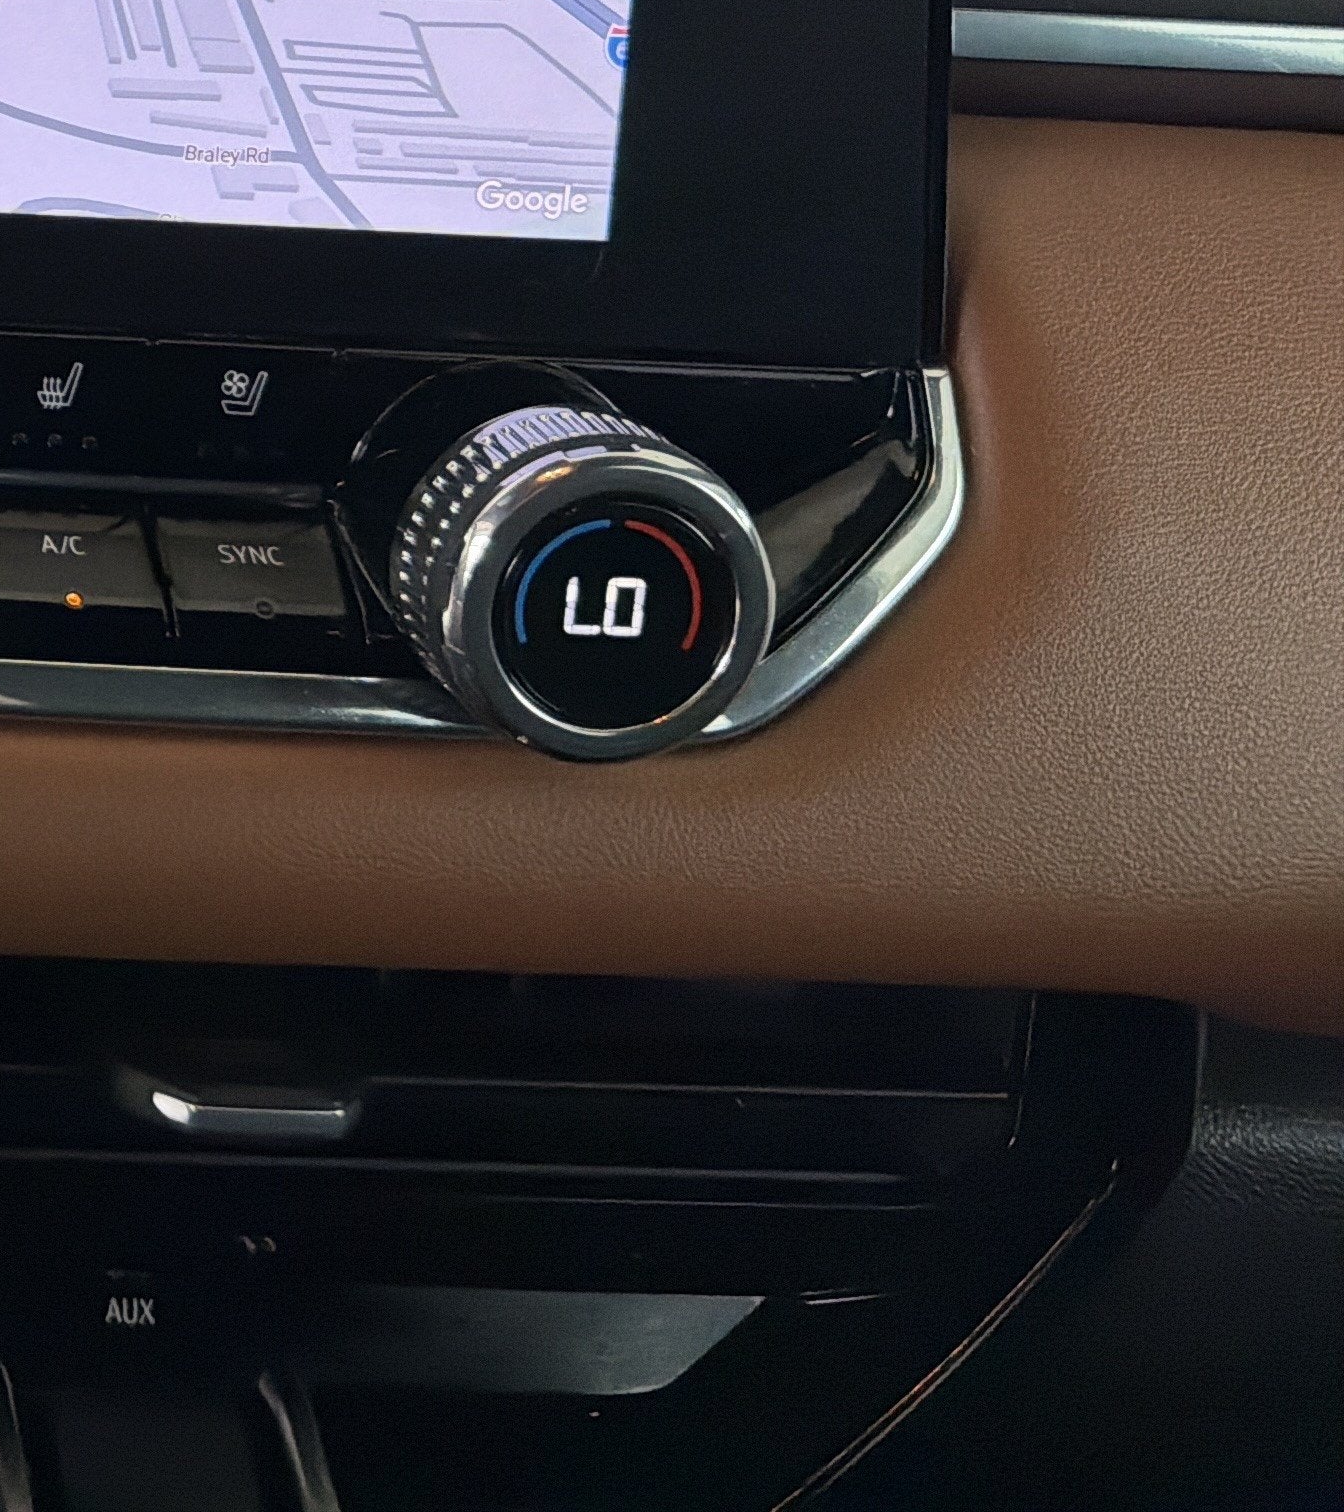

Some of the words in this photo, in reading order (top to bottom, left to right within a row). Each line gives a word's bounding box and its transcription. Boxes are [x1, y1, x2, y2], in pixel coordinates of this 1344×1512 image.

[184, 144, 240, 167] Braley
[245, 146, 270, 164] Rd
[475, 179, 588, 221] Google
[40, 533, 87, 556] A/C
[216, 542, 285, 568] SYNC
[104, 1296, 157, 1326] AUX
